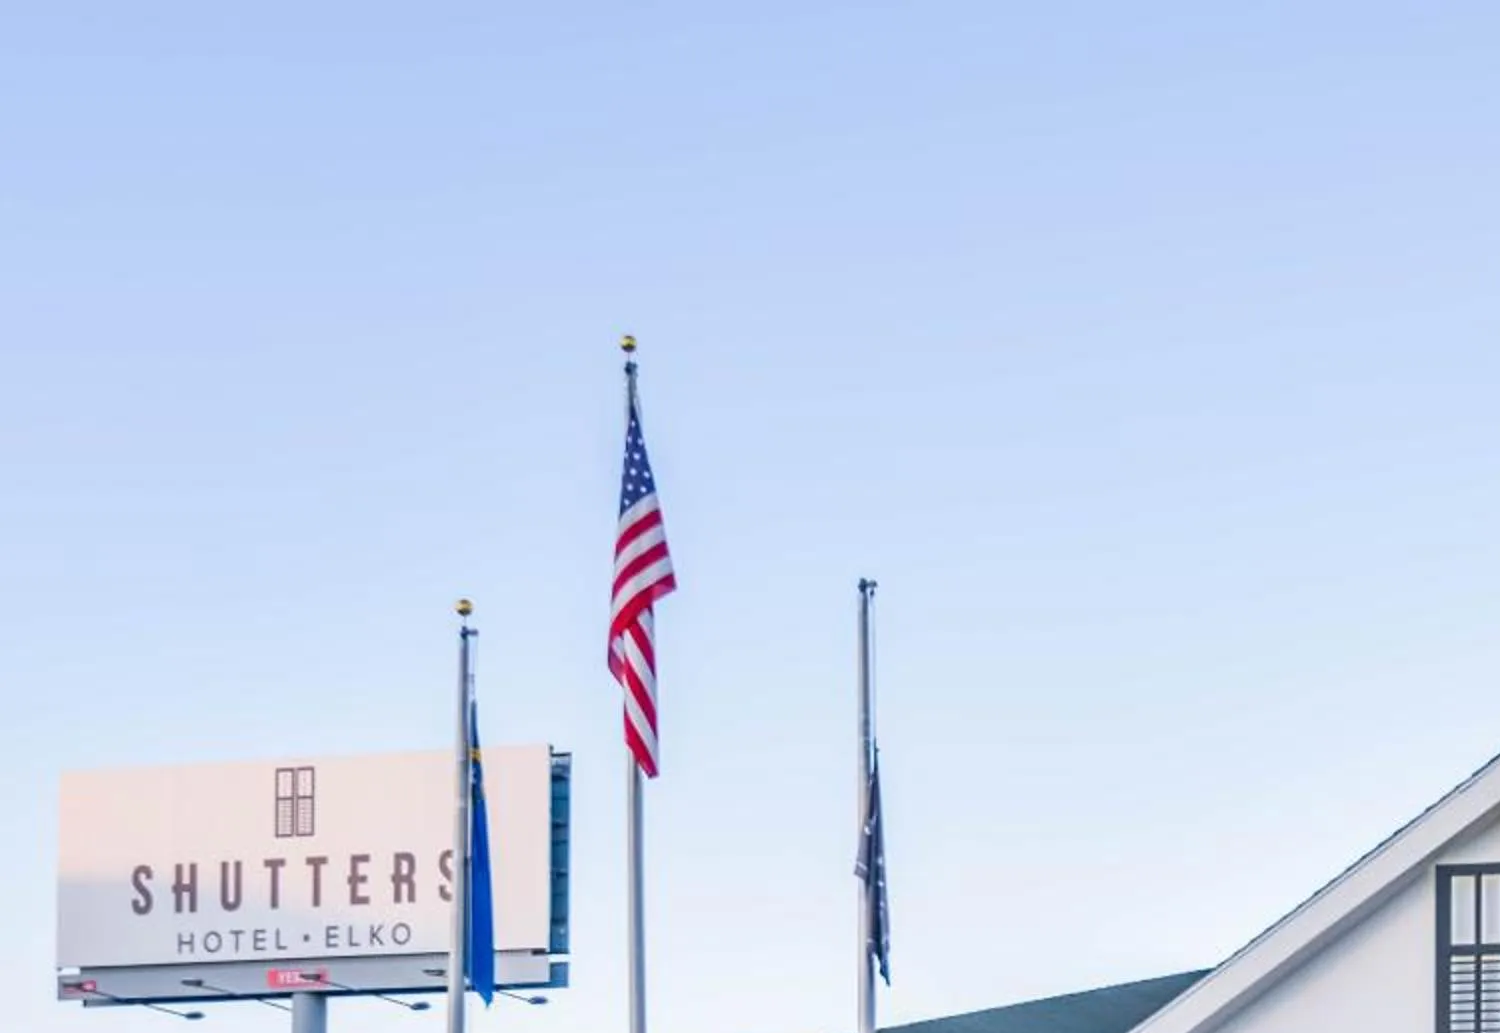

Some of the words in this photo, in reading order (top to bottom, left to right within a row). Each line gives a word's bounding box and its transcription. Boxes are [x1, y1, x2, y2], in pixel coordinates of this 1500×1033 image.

[131, 849, 454, 915] SHUTTERS
[177, 928, 287, 953] HOTEL
[325, 922, 412, 948] ELKO
